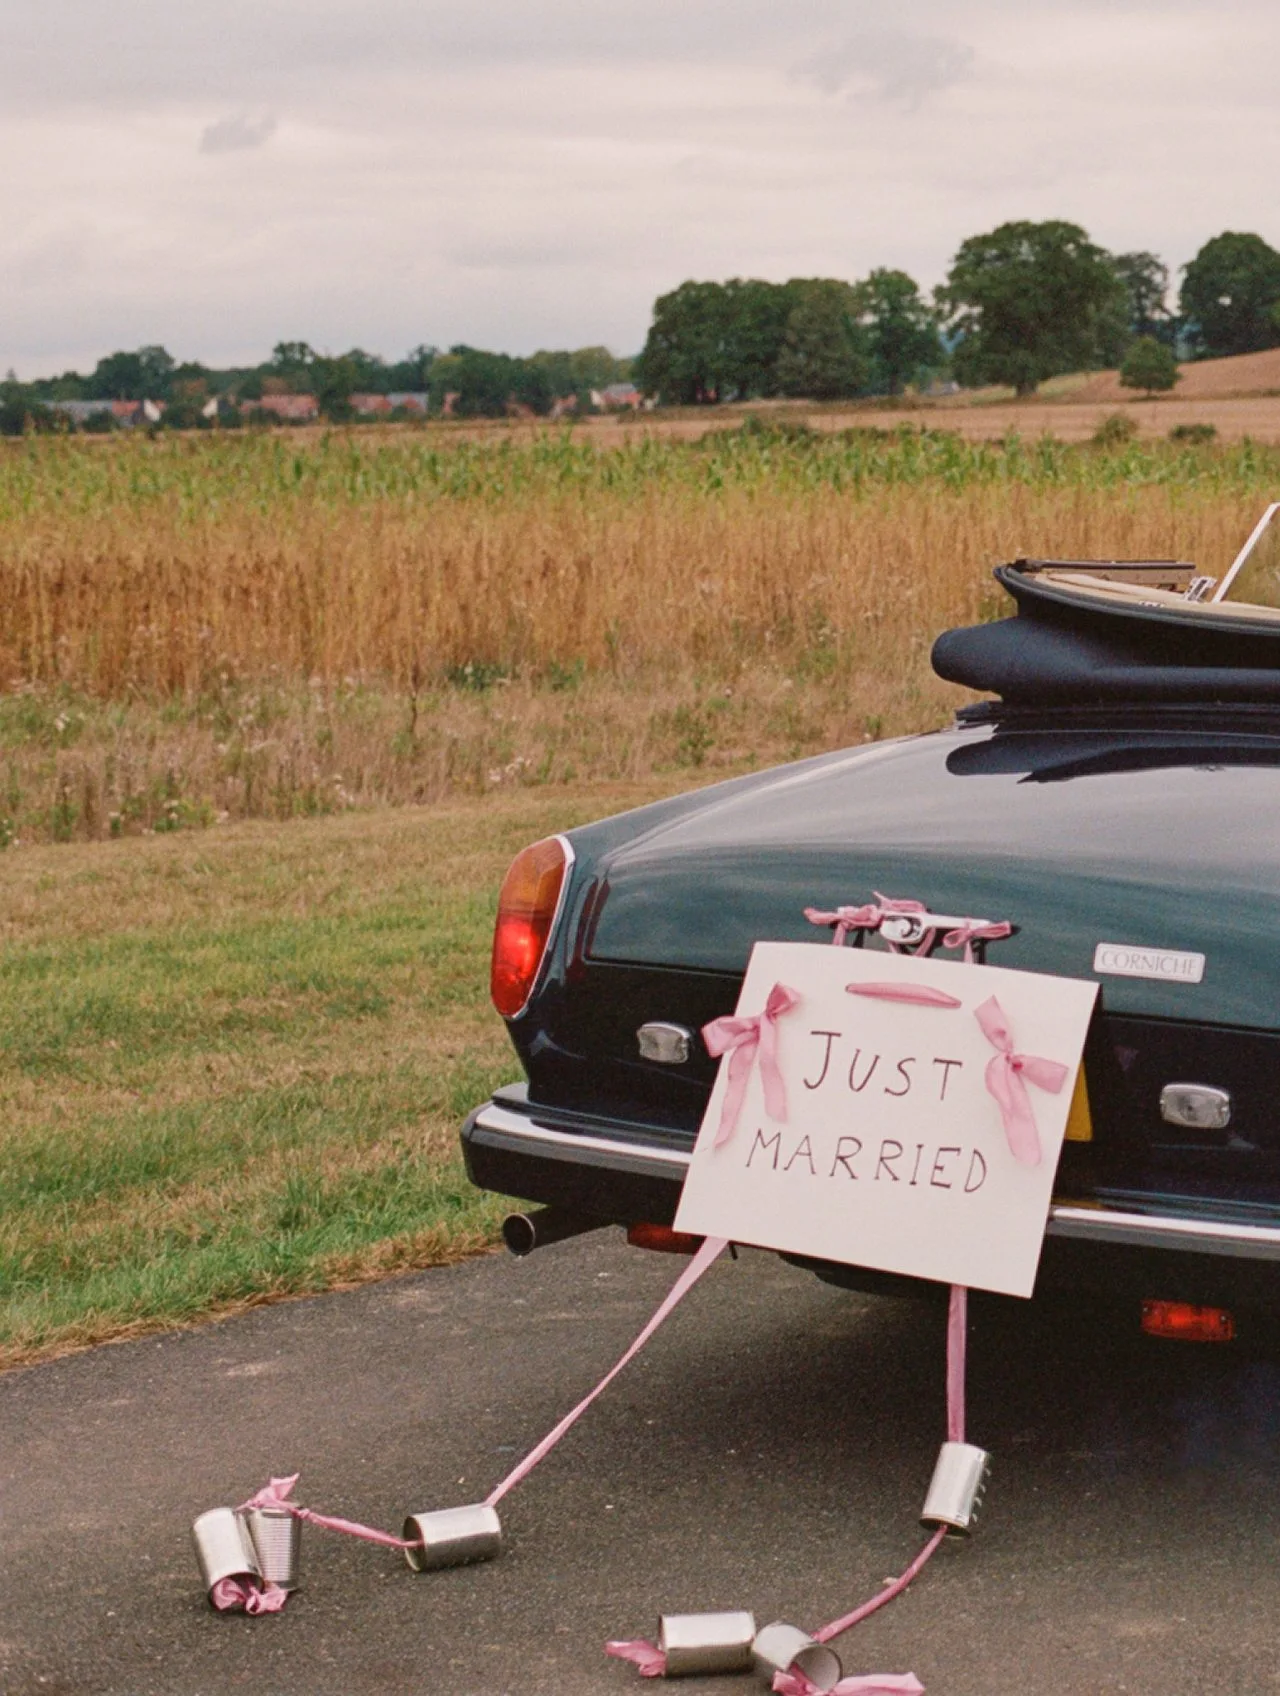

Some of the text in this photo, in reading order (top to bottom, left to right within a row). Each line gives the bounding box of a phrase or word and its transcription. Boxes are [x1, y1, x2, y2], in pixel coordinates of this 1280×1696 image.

[1101, 950, 1197, 976] CORNICHE
[803, 1030, 963, 1101] JUST
[745, 1128, 987, 1193] MARRIED
